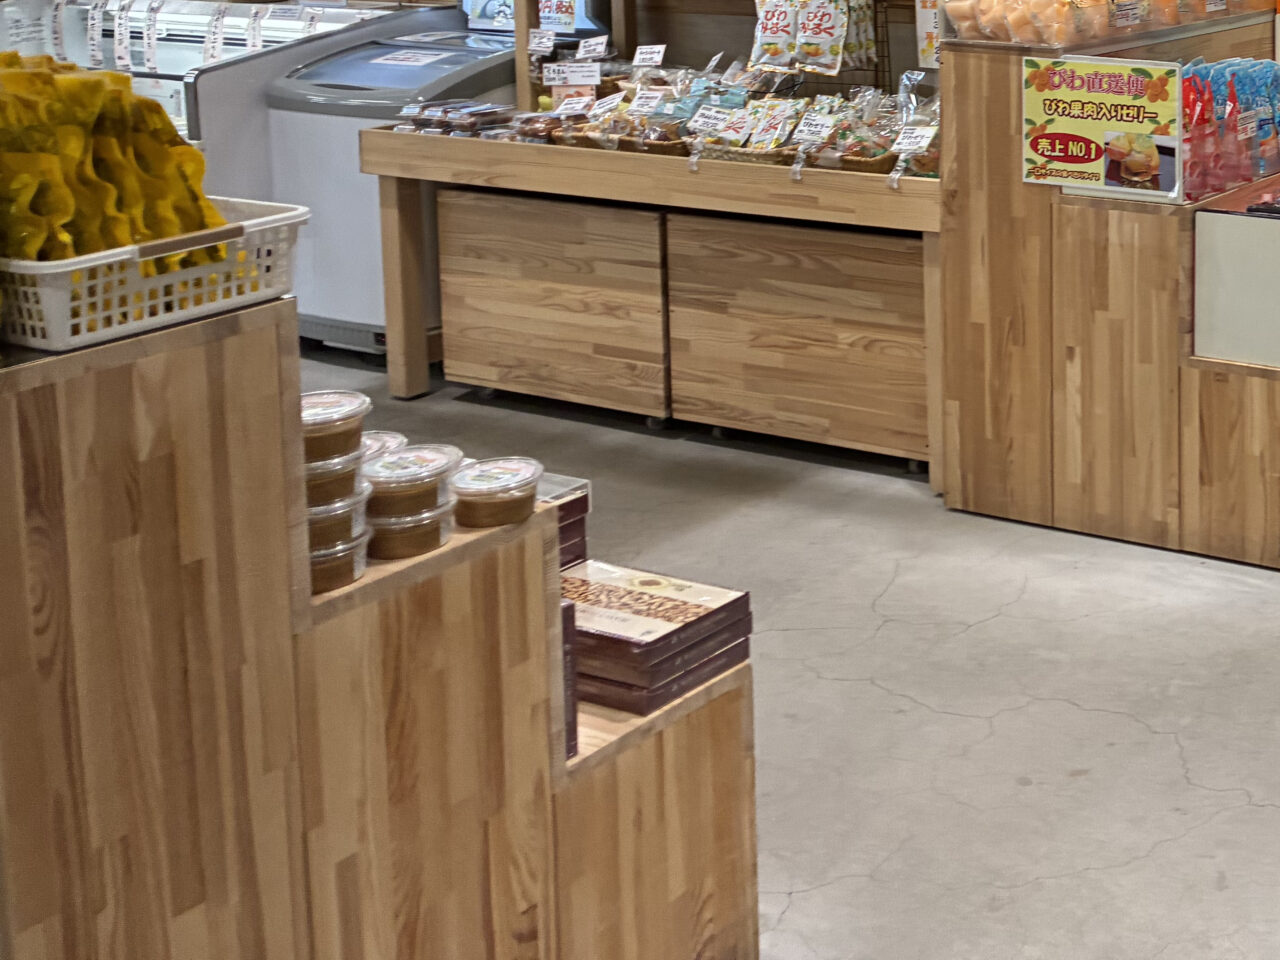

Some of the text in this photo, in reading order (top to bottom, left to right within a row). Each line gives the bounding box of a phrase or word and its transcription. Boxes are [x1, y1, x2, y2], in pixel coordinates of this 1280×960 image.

[764, 9, 788, 23] びわ
[806, 10, 833, 23] びわ
[760, 22, 792, 35] みるく
[799, 22, 835, 37] みるく
[1048, 68, 1146, 96] びわ直送便
[1043, 98, 1159, 123] びわ果肉入りゼリー
[1036, 138, 1097, 160] 売上 NO.1
